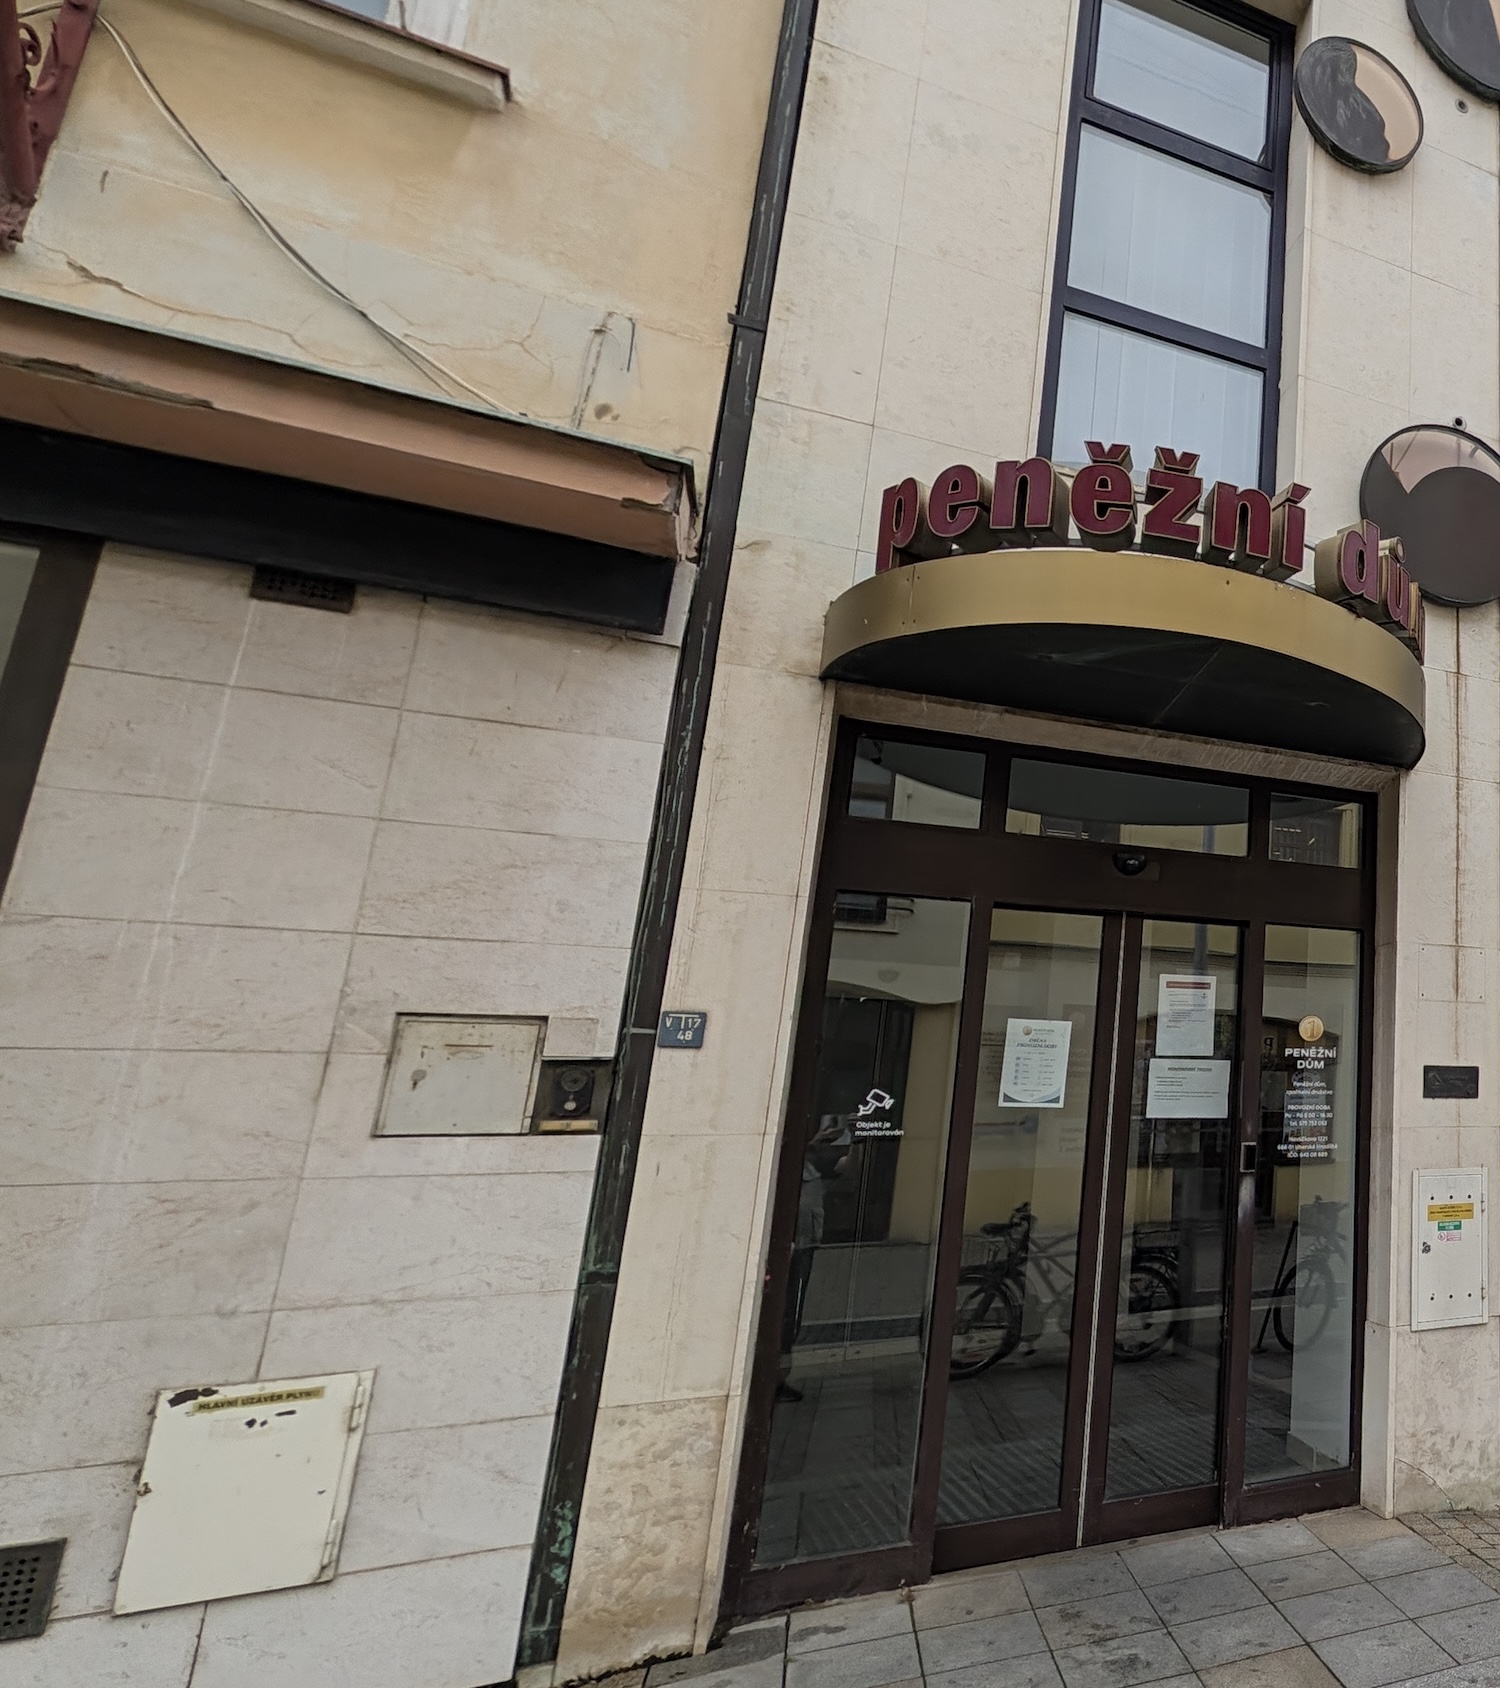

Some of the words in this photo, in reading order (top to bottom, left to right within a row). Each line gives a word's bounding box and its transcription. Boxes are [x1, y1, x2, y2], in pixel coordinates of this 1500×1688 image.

[876, 440, 1311, 575] peněžní
[1342, 518, 1426, 666] dů
[1284, 1046, 1337, 1058] PENĚŽNÍ
[1296, 1058, 1325, 1070] DŮM
[856, 1121, 882, 1129] Objekt
[882, 1121, 892, 1129] je
